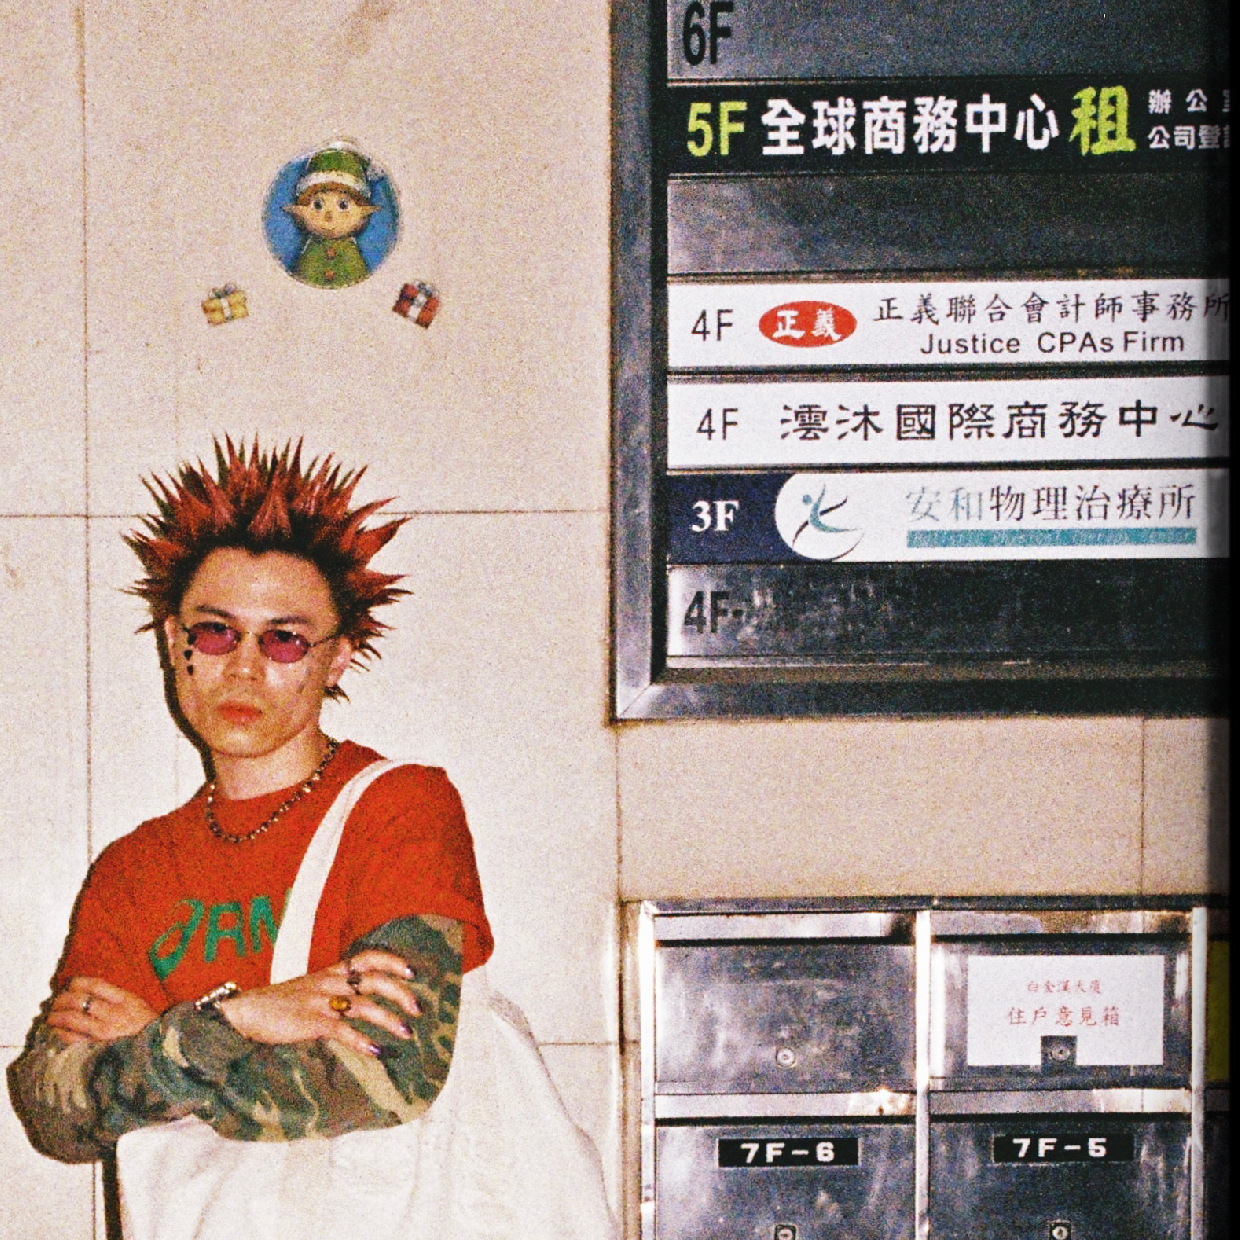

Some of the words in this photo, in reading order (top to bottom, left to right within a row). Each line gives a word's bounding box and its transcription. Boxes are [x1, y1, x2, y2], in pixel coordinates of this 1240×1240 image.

[681, 0, 733, 66] 6F
[686, 101, 748, 157] 5F
[760, 95, 1060, 155] 全球商務中心
[1070, 85, 1137, 156] 租
[873, 289, 1230, 325] 正義聯合會計師事務所
[691, 308, 734, 342] 4F
[772, 308, 843, 342] 正義
[920, 331, 1021, 355] Justice
[1037, 331, 1114, 354] CPAs
[1123, 330, 1185, 353] Firm
[697, 408, 738, 441] 4F
[780, 400, 1220, 442] 澐沐國際商務中心
[691, 500, 739, 533] 3F
[906, 484, 1197, 523] 安和物理治療所
[1007, 1006, 1121, 1027] 住戶意見箱
[740, 1143, 835, 1163] 7F-6
[1012, 1139, 1107, 1159] 7F-5
